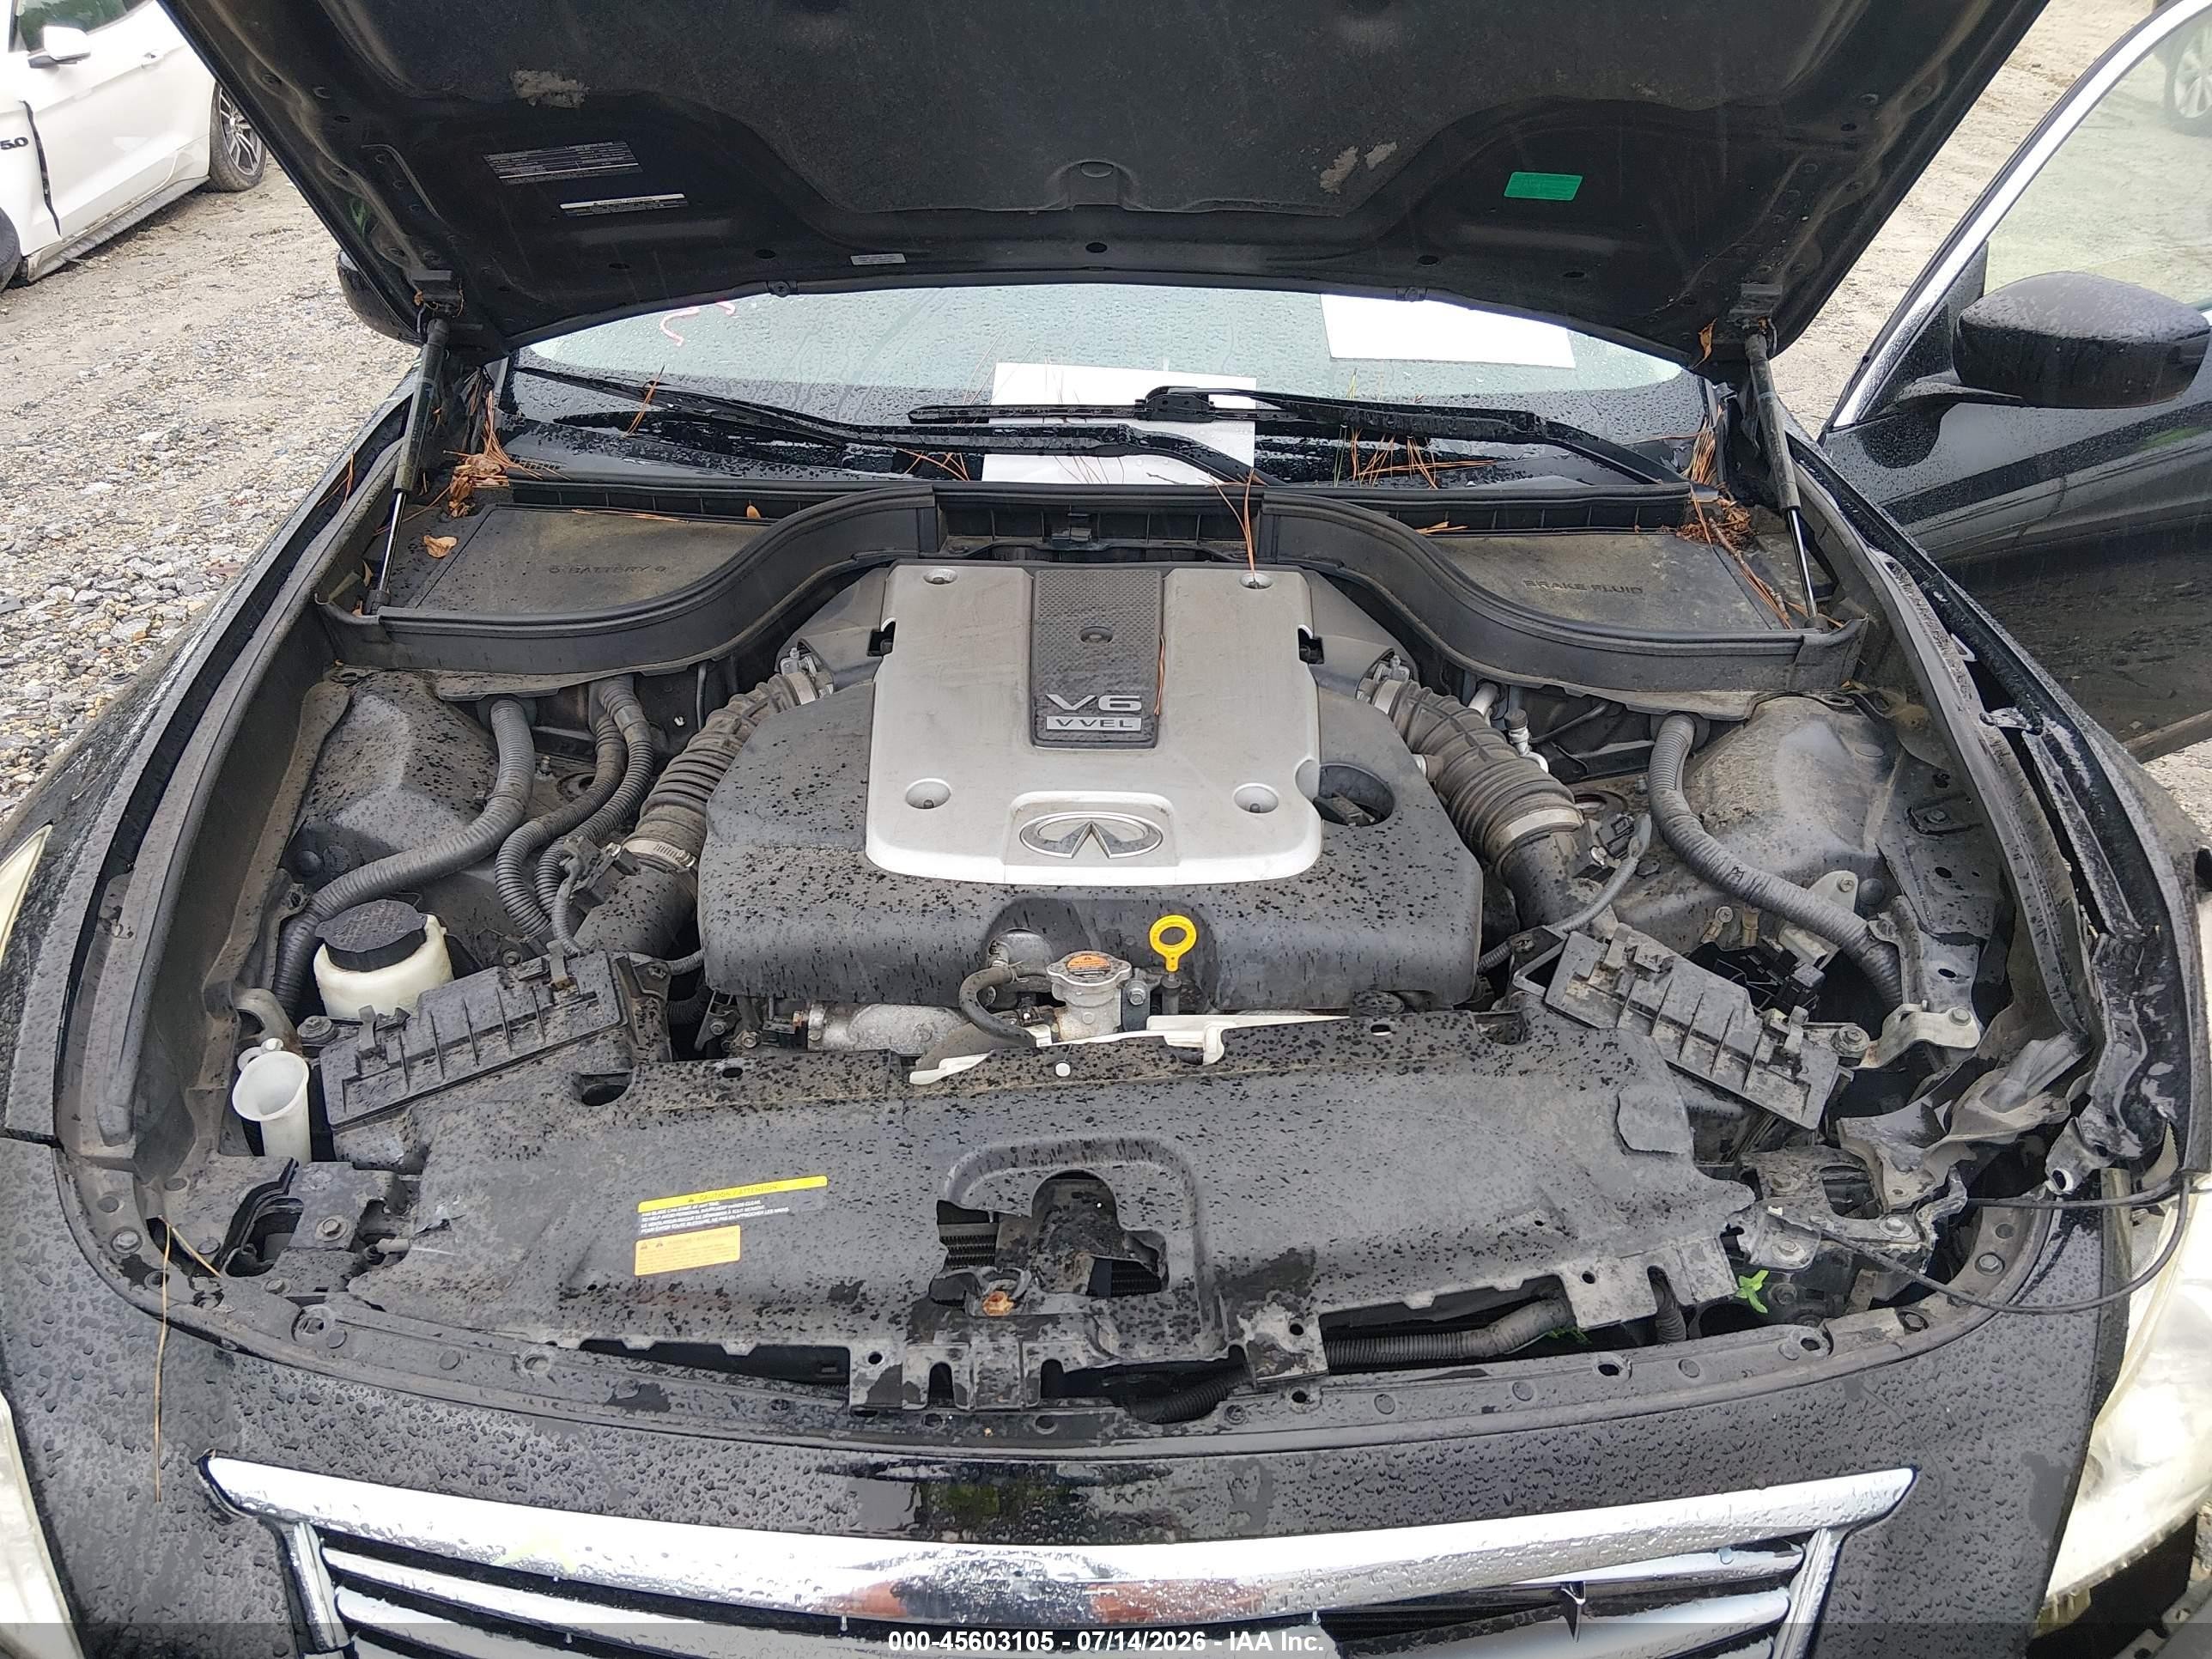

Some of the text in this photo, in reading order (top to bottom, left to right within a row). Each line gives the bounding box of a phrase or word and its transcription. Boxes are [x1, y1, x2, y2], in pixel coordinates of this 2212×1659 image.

[1522, 579, 1644, 594] BRAKE FLUID
[1045, 693, 1142, 712] V6
[1054, 719, 1133, 728] VVEL
